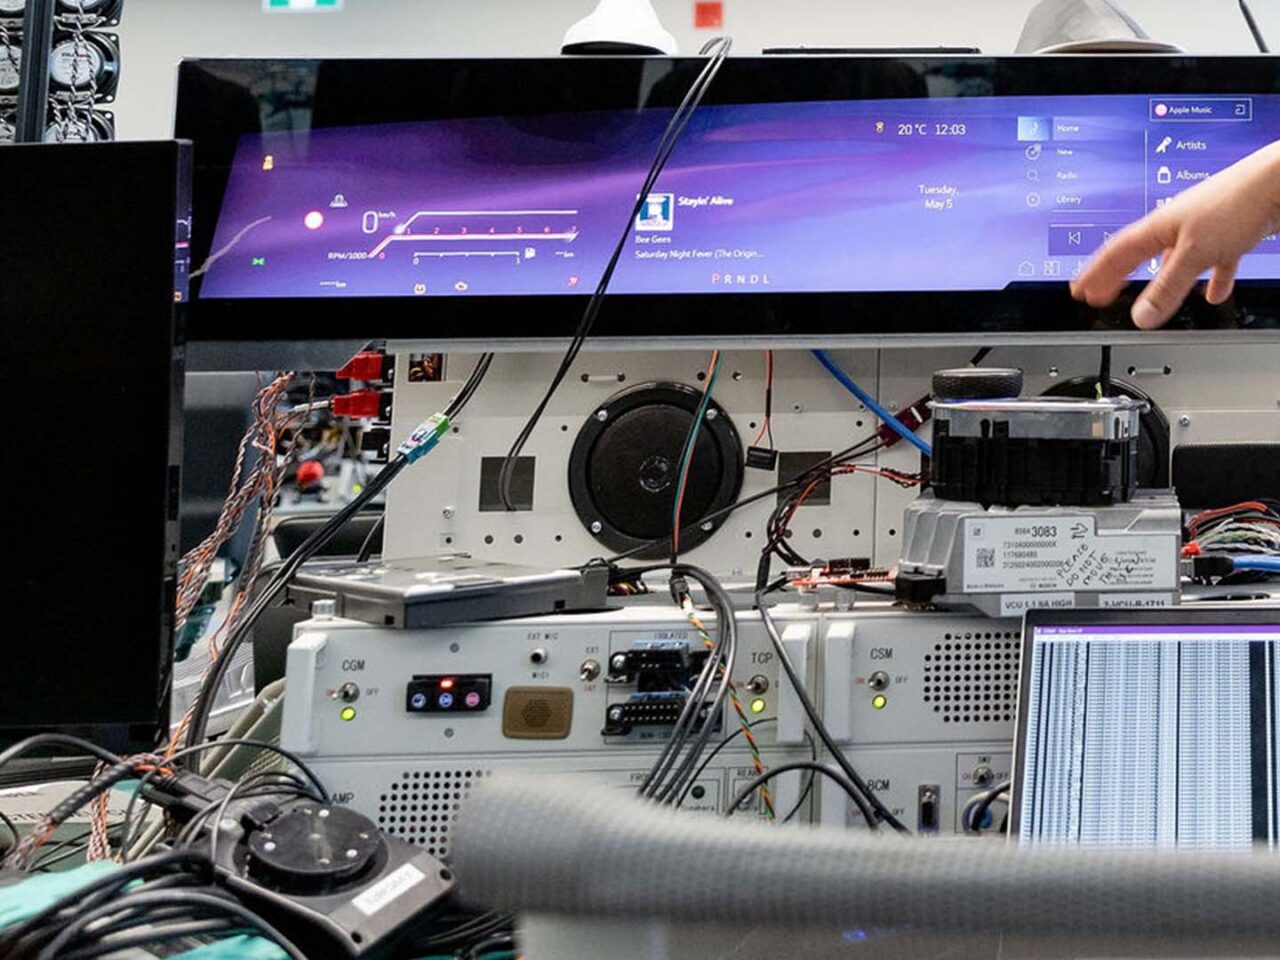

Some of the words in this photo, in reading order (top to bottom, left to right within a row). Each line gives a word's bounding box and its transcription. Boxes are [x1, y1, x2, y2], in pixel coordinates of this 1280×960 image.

[1168, 106, 1190, 114] Apple
[1191, 106, 1212, 114] Music
[898, 124, 912, 135] 20
[935, 124, 966, 135] 12:03
[1057, 124, 1079, 133] Home
[1176, 141, 1206, 150] Artists
[710, 196, 734, 206] Alive
[924, 200, 945, 210] May
[946, 199, 953, 209] 5
[362, 210, 379, 234] 0
[711, 273, 720, 284] P
[724, 274, 732, 284] R
[737, 274, 745, 284] N
[750, 274, 759, 284] D
[763, 274, 769, 284] L
[1031, 526, 1057, 538] 3083
[1079, 550, 1096, 573] NOT
[751, 653, 773, 664] TCP
[870, 648, 893, 660] CSM
[342, 658, 365, 672] CGM
[331, 791, 355, 804] AMP
